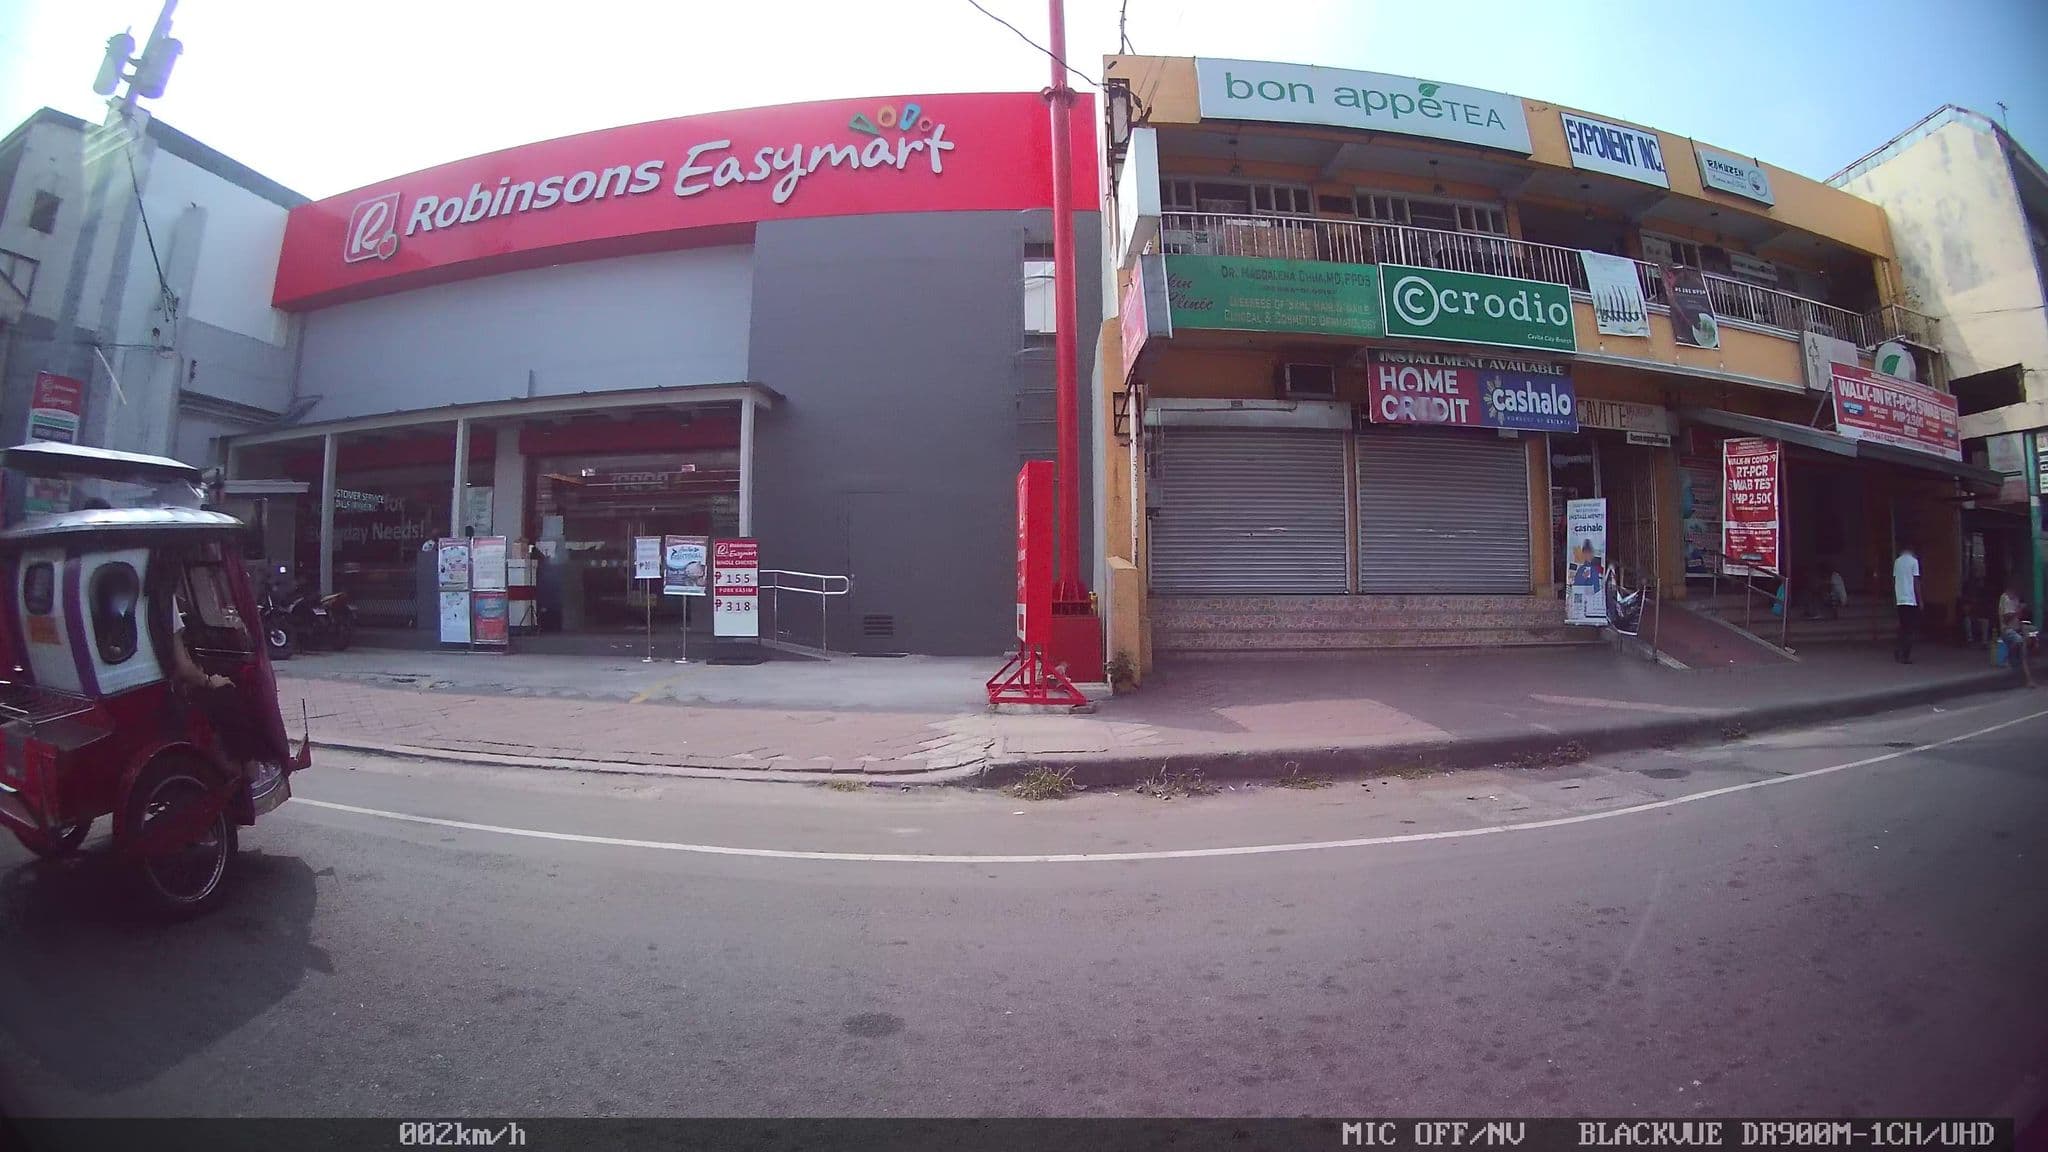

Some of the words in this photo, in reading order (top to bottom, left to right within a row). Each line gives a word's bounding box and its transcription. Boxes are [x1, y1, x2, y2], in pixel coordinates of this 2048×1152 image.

[1225, 72, 1315, 104] bon
[1565, 118, 1637, 166] EXPONENT
[404, 160, 665, 237] Robinsons
[674, 123, 954, 204] Easymart
[1168, 273, 1192, 289] kin
[1440, 289, 1569, 326] crodio
[1379, 351, 1484, 370] INSTALLMENT
[1489, 359, 1565, 376] AVAILABLE
[1379, 366, 1459, 394] HOME
[1838, 379, 1884, 405] WALK-IN
[1492, 381, 1571, 416] cashalo
[1736, 465, 1768, 478] RT-PCR
[1728, 478, 1753, 491] SWAB
[1574, 523, 1603, 532] cashalo
[726, 573, 751, 584] 155
[726, 601, 751, 612] 318
